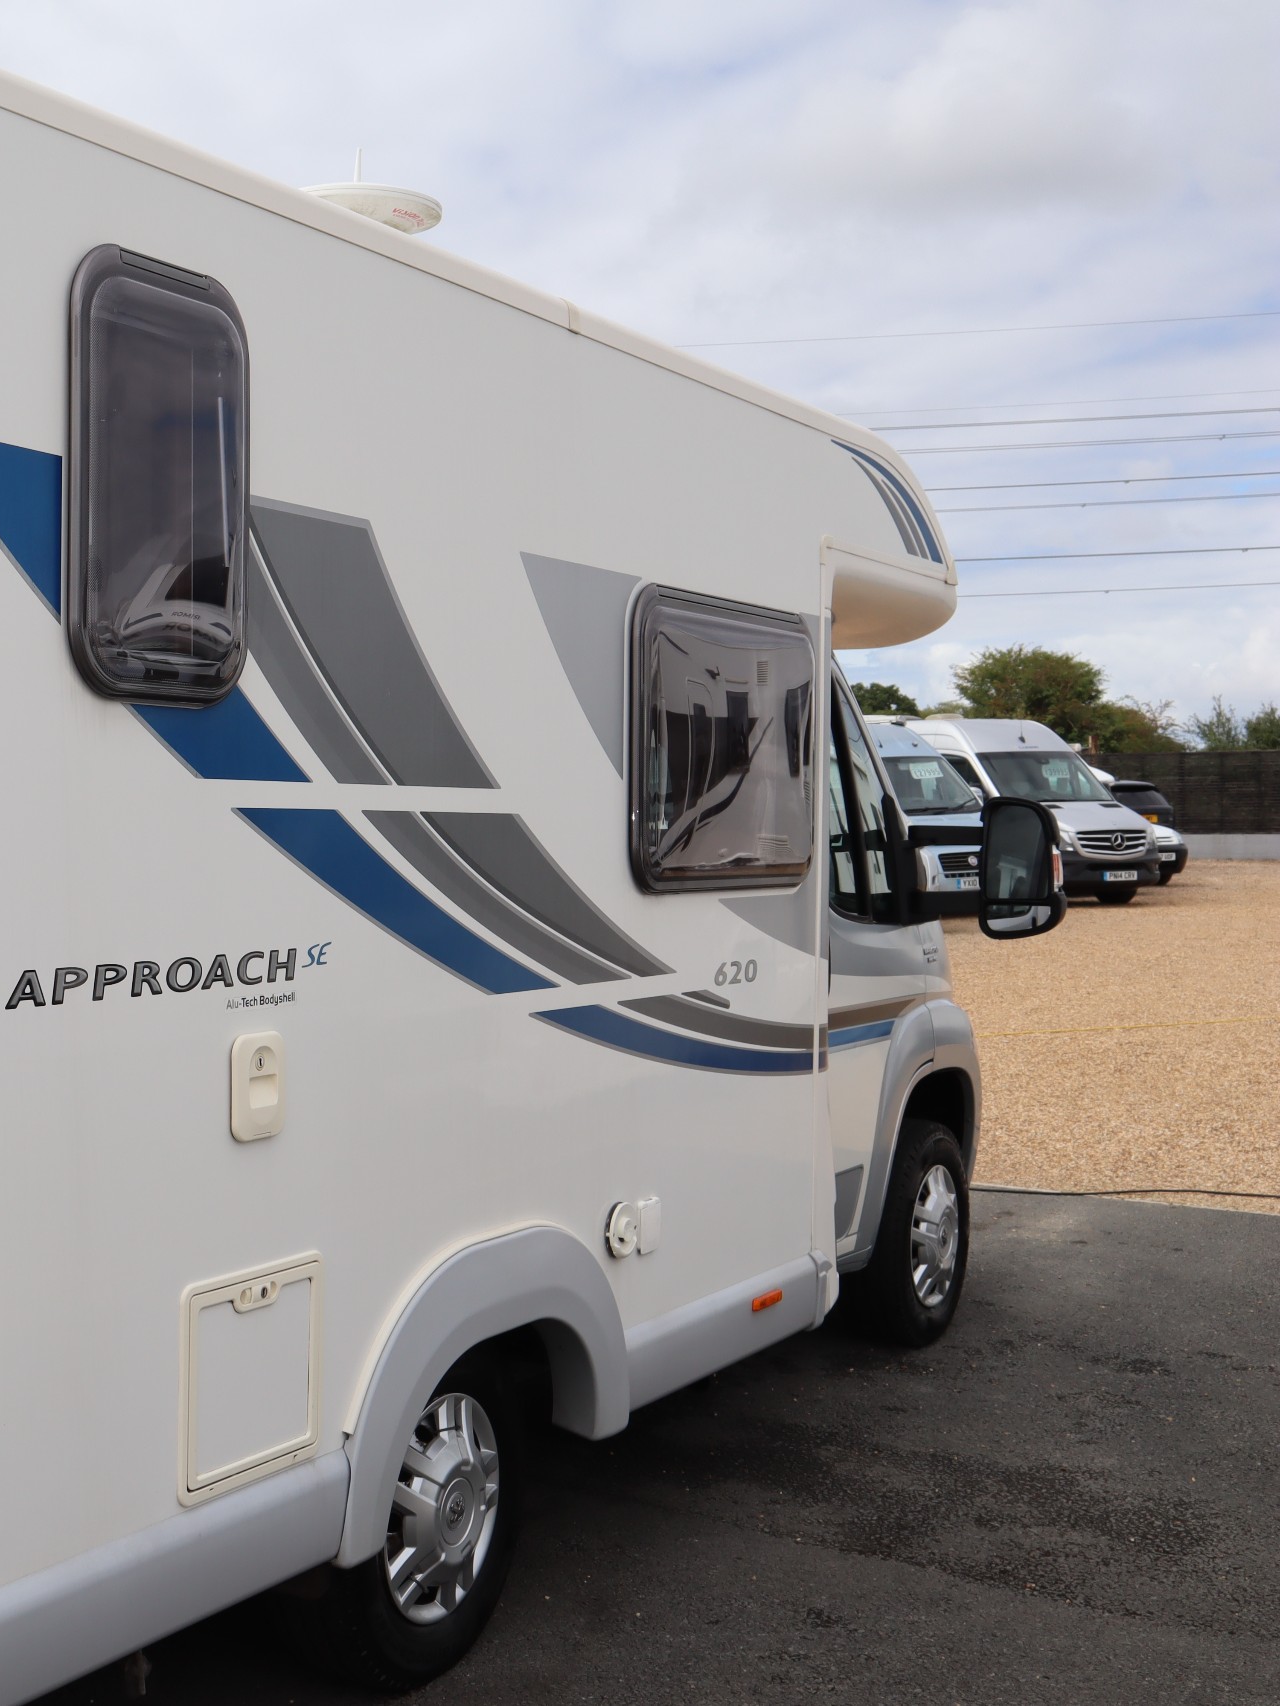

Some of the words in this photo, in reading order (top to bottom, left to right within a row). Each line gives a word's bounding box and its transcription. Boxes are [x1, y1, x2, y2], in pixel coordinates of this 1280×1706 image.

[4, 947, 297, 1010] APPROACH
[301, 941, 332, 969] SE
[714, 958, 758, 987] 620
[226, 995, 259, 1010] Alu-Tech
[259, 991, 296, 1007] Bodyshell
